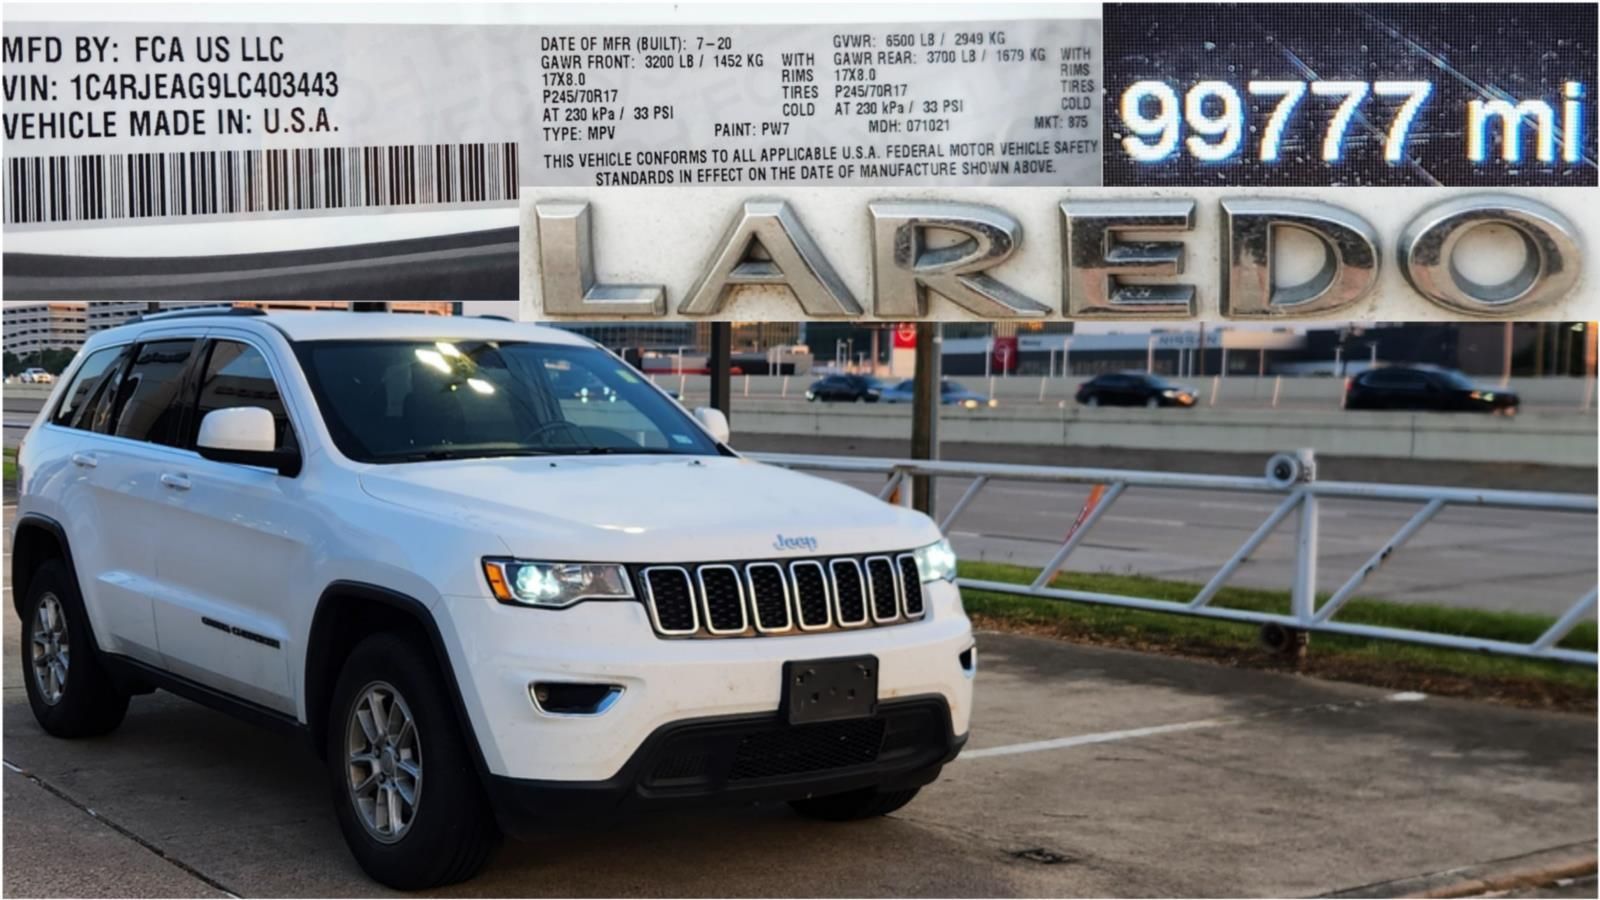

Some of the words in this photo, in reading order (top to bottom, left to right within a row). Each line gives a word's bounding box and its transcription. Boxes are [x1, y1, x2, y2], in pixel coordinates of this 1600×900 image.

[541, 37, 575, 51] DATE
[581, 37, 596, 51] OF
[604, 37, 630, 50] MFR
[637, 36, 687, 53] (BUILT):
[833, 34, 876, 48] GVWR:
[886, 34, 914, 47] 6500
[921, 33, 934, 46] LB
[940, 33, 944, 46] /
[955, 33, 983, 45] 2949
[990, 32, 1005, 44] KG
[3, 37, 61, 62] MFD
[76, 37, 118, 62] BY:
[136, 36, 184, 62] FCA
[197, 36, 229, 62] US
[242, 36, 283, 62] LLC
[1062, 47, 1091, 60] WITH
[542, 55, 581, 69] GAWR
[588, 55, 634, 68] FRONT:
[645, 55, 673, 68] 3200
[680, 54, 693, 68] LB
[699, 55, 704, 67] /
[714, 54, 742, 67] 1452
[747, 54, 763, 67] KG
[782, 53, 814, 66] WITH
[834, 52, 872, 65] GAWR
[878, 51, 917, 64] REAR:
[928, 51, 956, 63] 3700
[962, 49, 976, 62] LB
[982, 49, 986, 61] /
[997, 49, 1024, 61] 1679
[1031, 48, 1046, 61] KG
[782, 69, 813, 82] RIMS
[836, 68, 875, 81] 17X8.0
[1061, 63, 1090, 76] RIMS
[543, 72, 585, 86] 17X8.0
[1062, 79, 1095, 93] TIRES
[3, 75, 56, 101] VIN:
[71, 72, 338, 101] 1C4RJEAG9LC403443
[782, 86, 818, 99] TIRES
[835, 84, 907, 98] P245/70R17
[543, 89, 617, 103] P245/70R17
[1062, 96, 1091, 110] COLD
[543, 108, 559, 121] AT
[565, 108, 587, 121] 230
[592, 107, 614, 120] kPa
[620, 107, 624, 120] /
[634, 107, 648, 120] 33
[654, 106, 673, 119] PSI
[783, 103, 815, 116] COLD
[835, 102, 850, 115] AT
[857, 102, 877, 115] 230
[882, 101, 904, 114] kPa
[909, 101, 913, 113] /
[923, 101, 937, 113] 33
[943, 100, 962, 112] PSI
[3, 111, 116, 139] VEHICLE
[130, 110, 205, 136] MADE
[218, 109, 251, 134] IN:
[264, 107, 338, 133] U.S.A.
[869, 120, 900, 132] MDH:
[907, 119, 949, 132] 071021
[1035, 115, 1063, 128] MKT:
[1069, 115, 1088, 128] 875
[1121, 80, 1432, 163] 99777
[1466, 81, 1585, 163] mi
[543, 127, 581, 141] TYPE:
[588, 126, 615, 140] MPV
[715, 123, 755, 136] PAINT:
[762, 122, 789, 135] PW7
[544, 154, 574, 168] THIS
[579, 152, 631, 167] VEHICLE
[637, 150, 707, 165] CONFORMS
[712, 149, 728, 163] TO
[733, 149, 756, 162] ALL
[761, 147, 836, 161] APPLICABLE
[843, 146, 880, 159] U.S.A.
[887, 144, 944, 158] FEDERAL
[950, 143, 994, 156] MOTOR
[1002, 141, 1049, 155] VEHICLE
[1054, 140, 1098, 154] SAFETY
[596, 170, 673, 186] STANDARDS
[680, 170, 691, 182] IN
[698, 168, 743, 182] EFFECT
[749, 168, 766, 180] ON
[771, 166, 795, 180] THE
[801, 165, 833, 179] DATE
[839, 165, 854, 178] OF
[860, 162, 956, 177] MANUFACTURE
[963, 162, 1009, 175] SHOWN
[1014, 160, 1056, 173] ABOVE.
[534, 193, 1583, 320] LAREDO
[772, 533, 818, 552] Jeep
